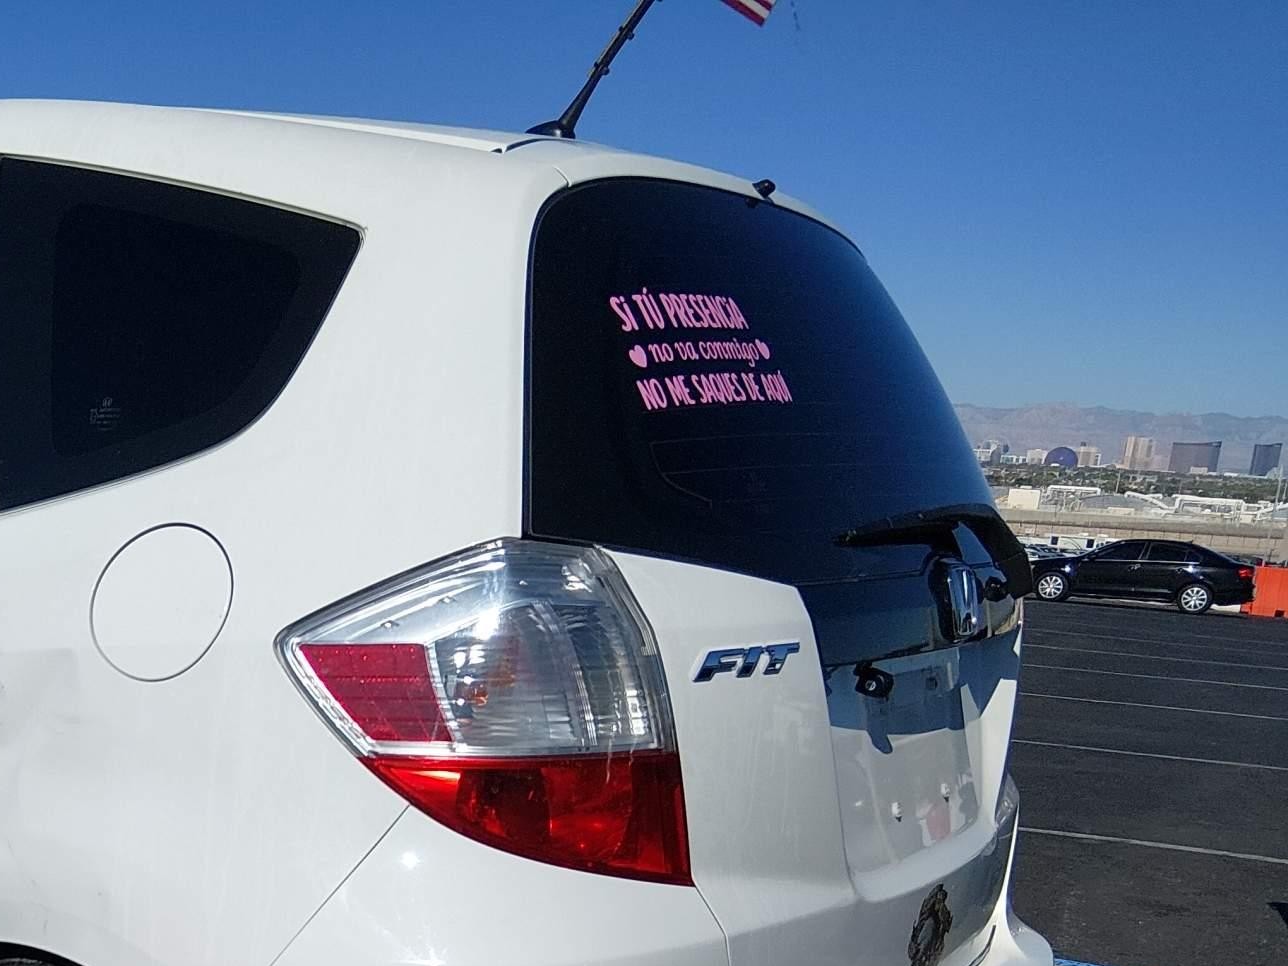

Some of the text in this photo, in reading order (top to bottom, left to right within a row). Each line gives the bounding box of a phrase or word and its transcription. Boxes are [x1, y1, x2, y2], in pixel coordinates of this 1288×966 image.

[631, 286, 665, 329] TÚ
[648, 337, 760, 367] no va conmigo
[636, 369, 793, 411] NO ME SAQUES DE AQUÍ
[691, 641, 800, 682] FIT
